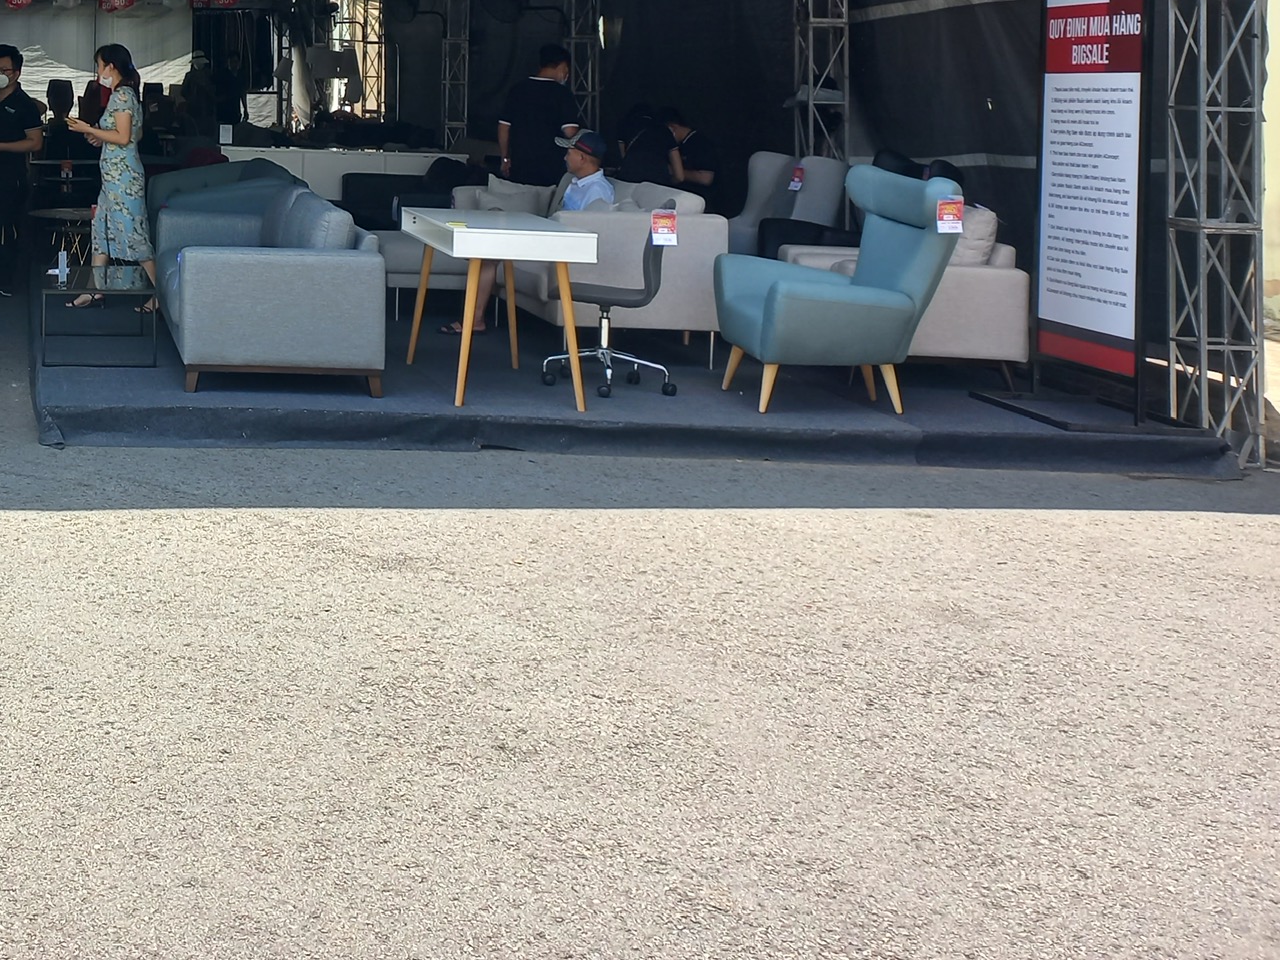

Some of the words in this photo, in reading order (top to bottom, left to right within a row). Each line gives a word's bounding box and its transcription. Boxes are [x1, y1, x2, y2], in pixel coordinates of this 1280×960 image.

[1049, 19, 1066, 40] QUY
[1066, 17, 1087, 41] ĐỊNH
[1089, 15, 1110, 37] MUA
[1112, 11, 1141, 36] HÀNG
[1071, 44, 1110, 65] BIGSALE
